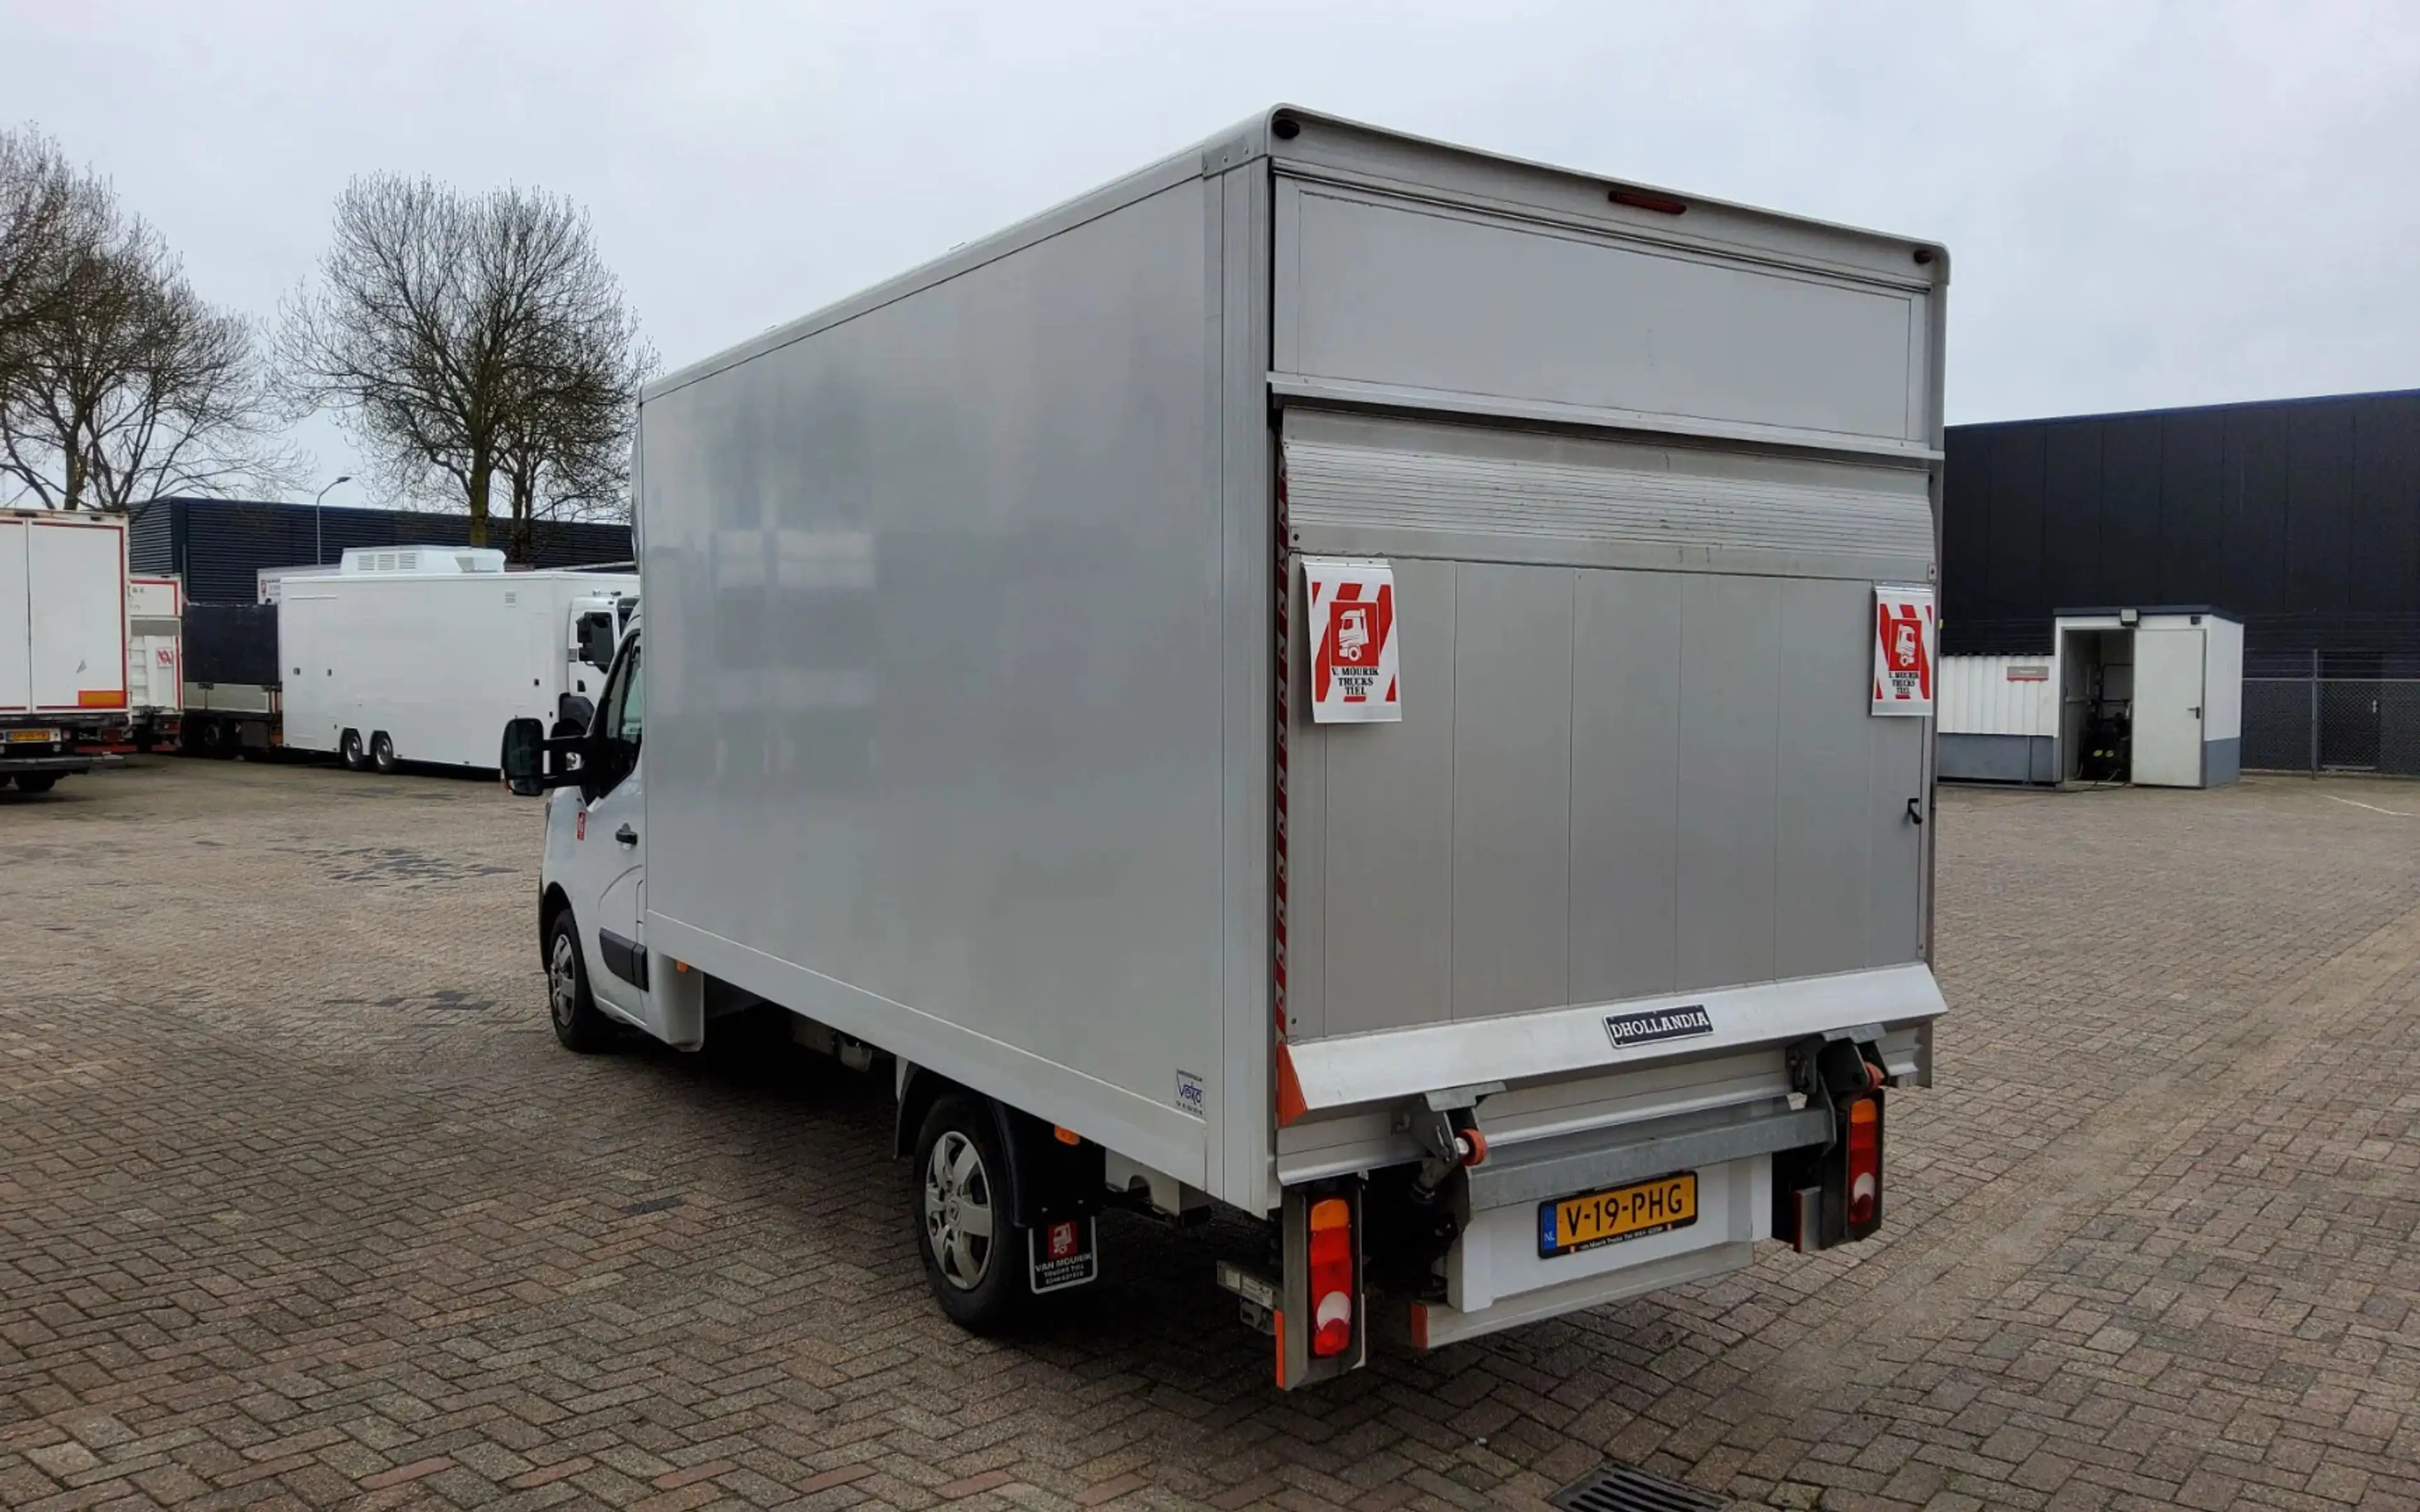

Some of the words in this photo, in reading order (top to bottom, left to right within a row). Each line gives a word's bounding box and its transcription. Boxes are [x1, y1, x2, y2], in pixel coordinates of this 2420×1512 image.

[1342, 668, 1379, 676] MOURIK
[1338, 677, 1374, 686] TRUCKS
[1345, 687, 1366, 695] TIEL
[1610, 1012, 1710, 1038] DHOLLANDIA
[1566, 1184, 1683, 1237] V-19-PHG
[1544, 1232, 1555, 1242] NL
[1035, 1261, 1054, 1272] VAN
[1056, 1253, 1092, 1268] MOURIK
